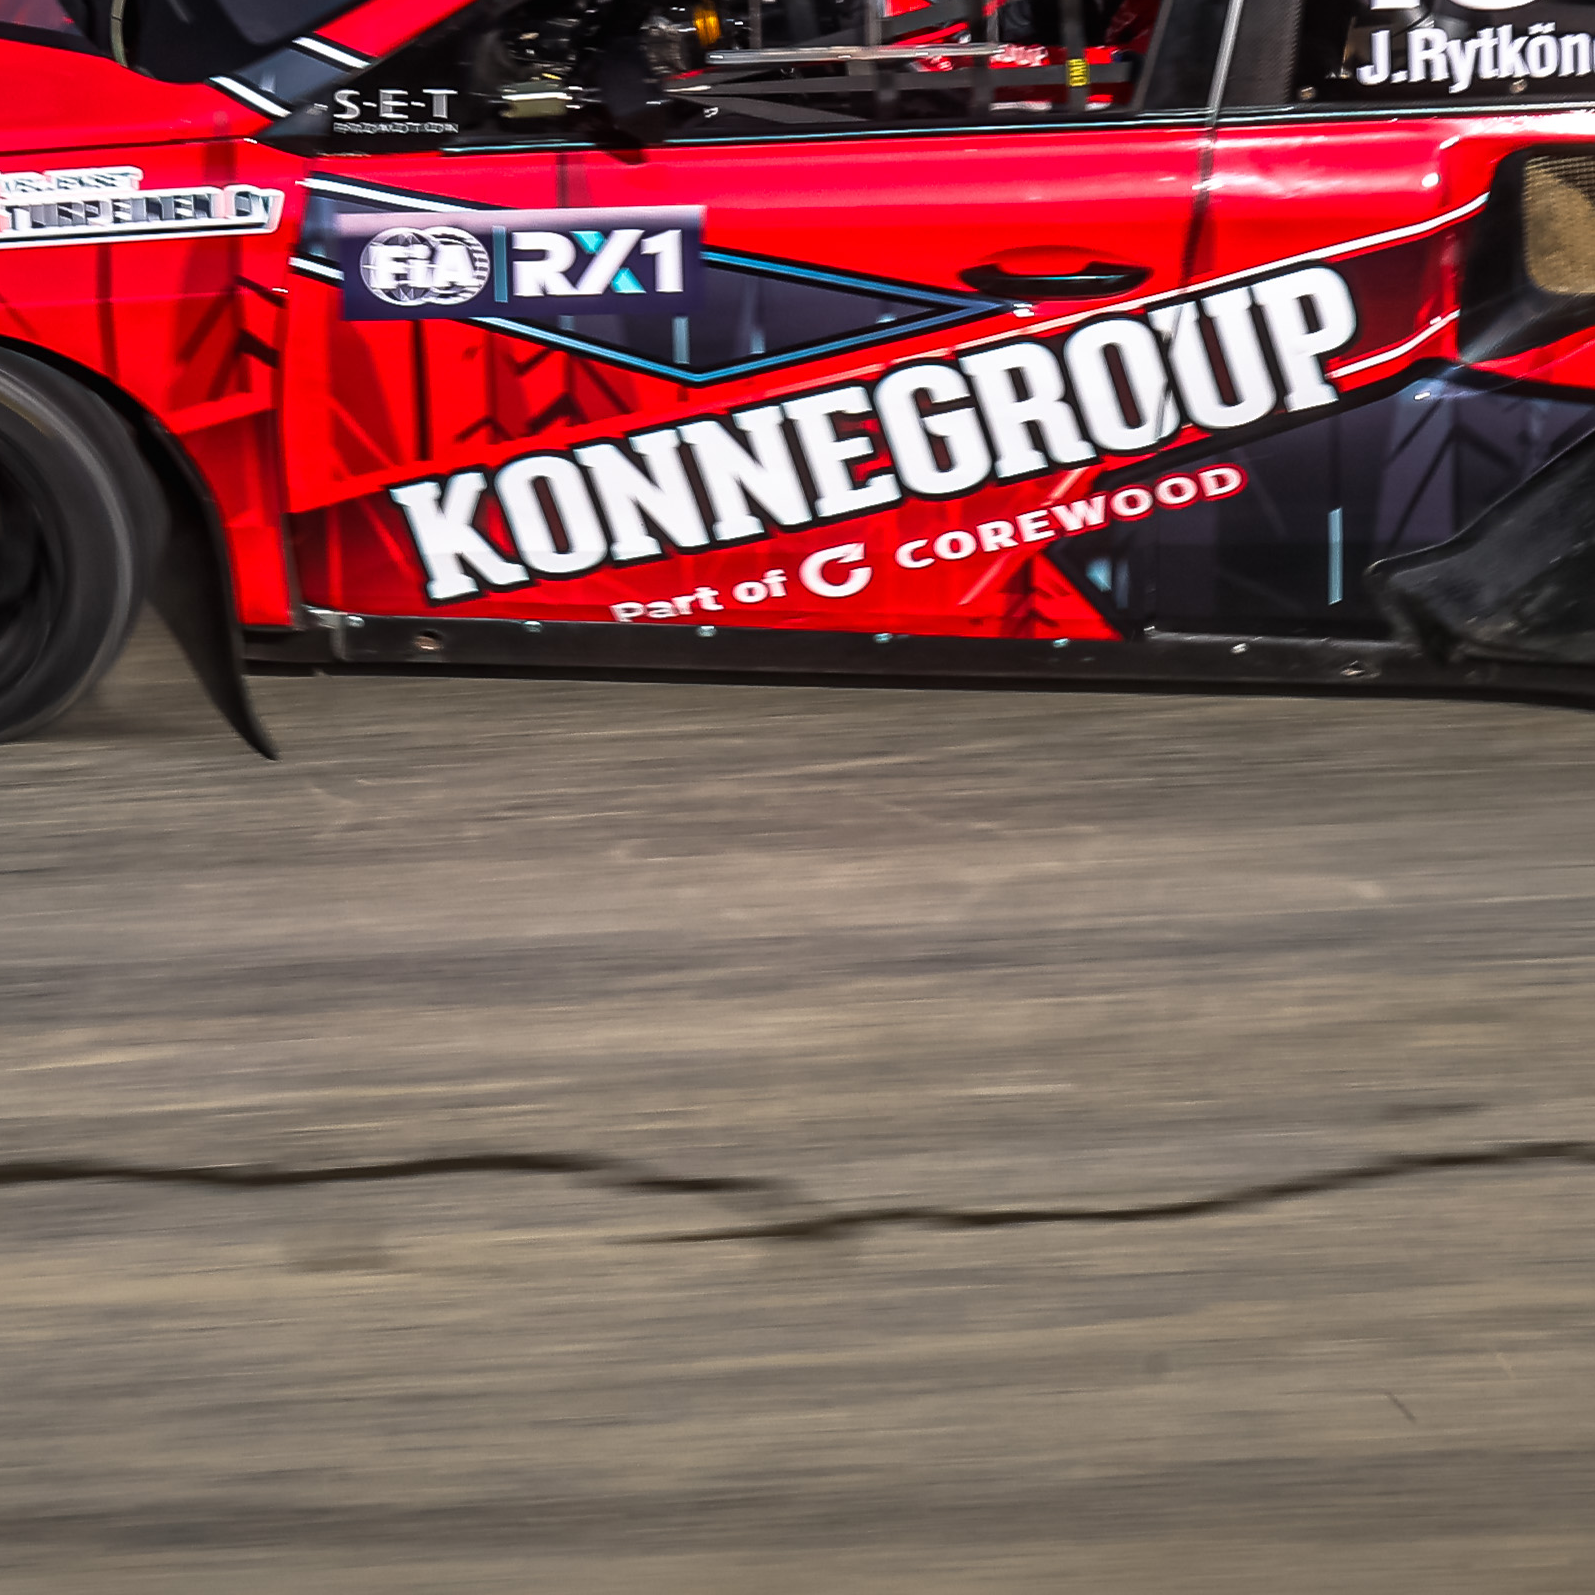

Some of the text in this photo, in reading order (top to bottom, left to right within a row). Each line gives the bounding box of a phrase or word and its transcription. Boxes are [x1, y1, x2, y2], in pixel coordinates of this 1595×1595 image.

[511, 228, 684, 298] RX1
[391, 265, 1358, 602] KONNEGROUP
[610, 585, 724, 623] Part
[732, 568, 789, 605] of
[895, 463, 1245, 570] COREWOOD
